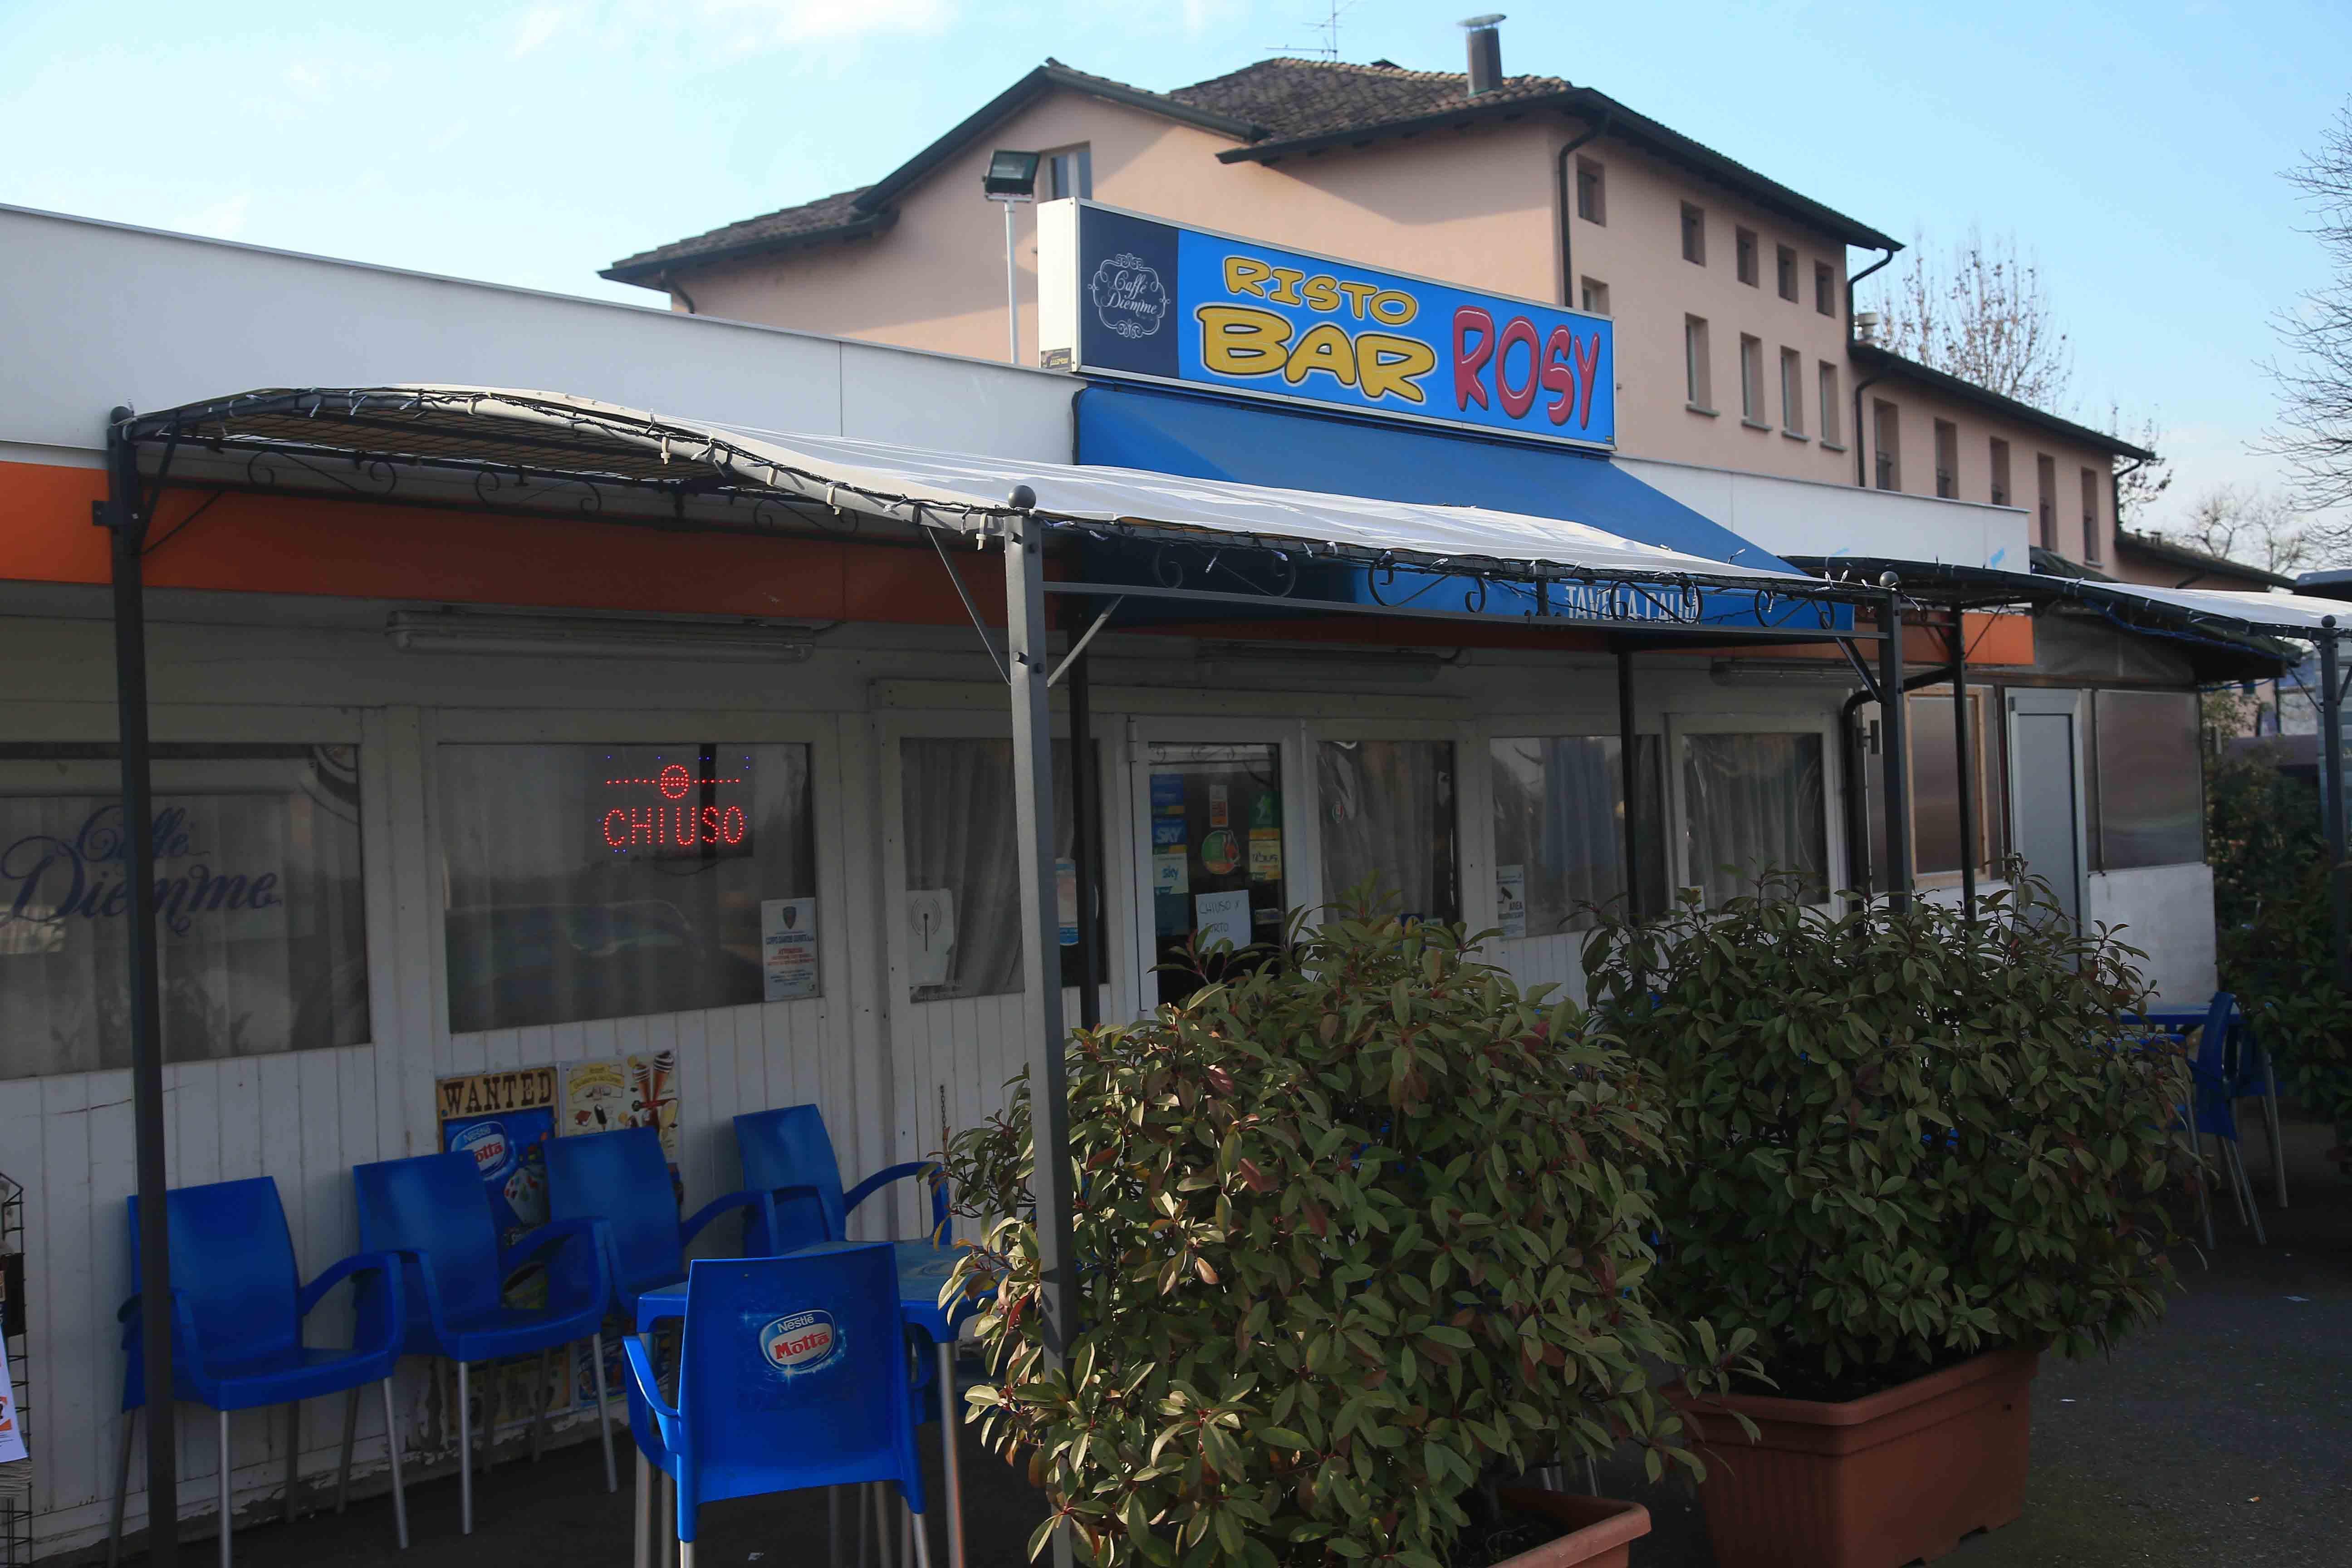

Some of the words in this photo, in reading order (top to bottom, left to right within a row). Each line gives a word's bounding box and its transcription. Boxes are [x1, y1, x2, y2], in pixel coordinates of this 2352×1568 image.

[1222, 255, 1418, 325] RISTO
[1196, 306, 1436, 404] BAR
[1453, 305, 1602, 431] ROSY
[603, 805, 744, 846] CHIUSO
[443, 1072, 552, 1115] WANTED
[474, 1142, 504, 1162] otta
[774, 1332, 830, 1360] Motta
